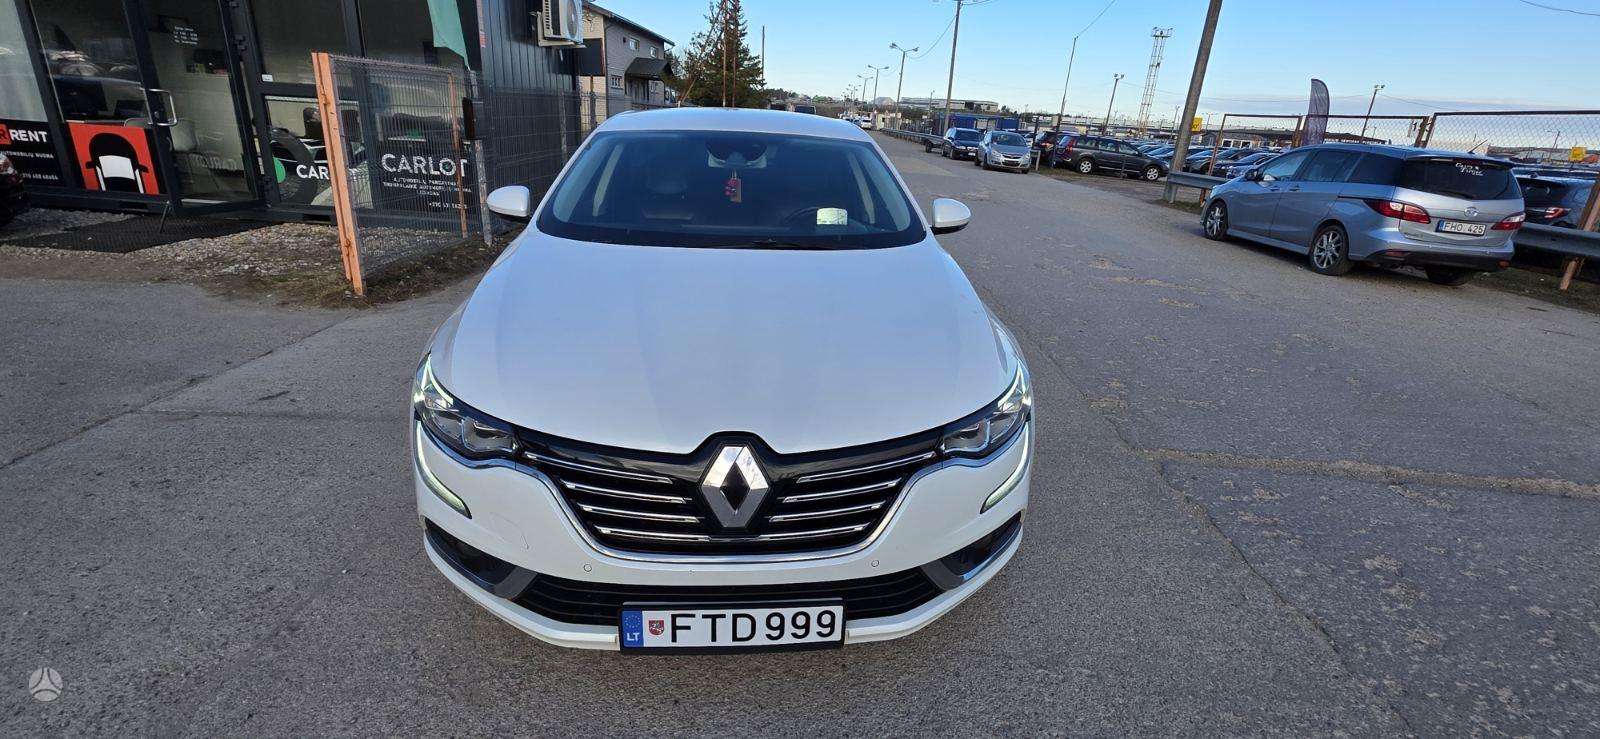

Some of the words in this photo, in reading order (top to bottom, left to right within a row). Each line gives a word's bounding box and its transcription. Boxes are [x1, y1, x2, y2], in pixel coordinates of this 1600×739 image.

[9, 129, 48, 142] RENT
[381, 153, 468, 177] CARLOT
[1444, 222, 1463, 232] FHO
[1467, 224, 1484, 234] 425
[626, 632, 640, 642] LT
